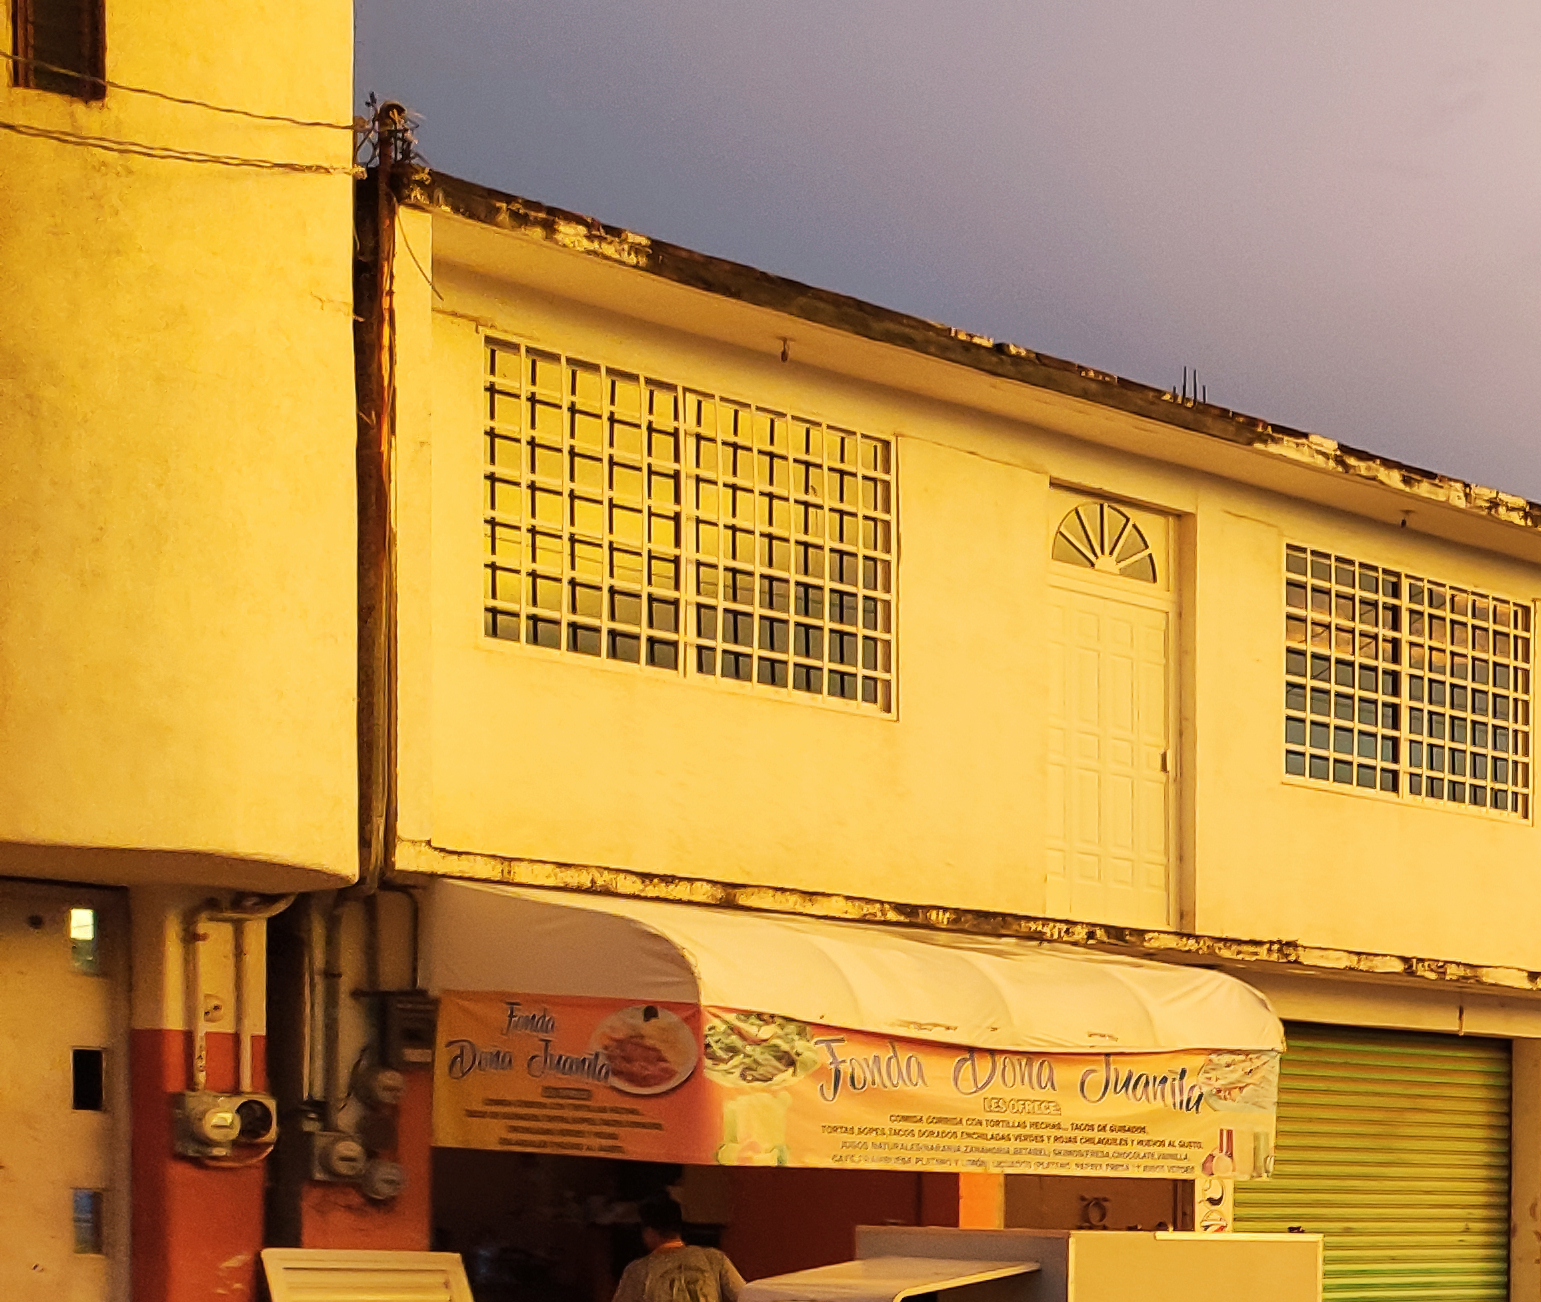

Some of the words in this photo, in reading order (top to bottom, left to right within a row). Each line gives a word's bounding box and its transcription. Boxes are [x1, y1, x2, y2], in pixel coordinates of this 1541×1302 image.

[501, 1000, 557, 1036] Fonda
[526, 1038, 613, 1083] Juanita
[811, 1036, 930, 1103] Fonda
[1078, 1052, 1206, 1115] Juanita
[983, 1096, 1008, 1113] LES
[965, 1117, 983, 1128] CON
[985, 1118, 1028, 1130] TORTILLAS
